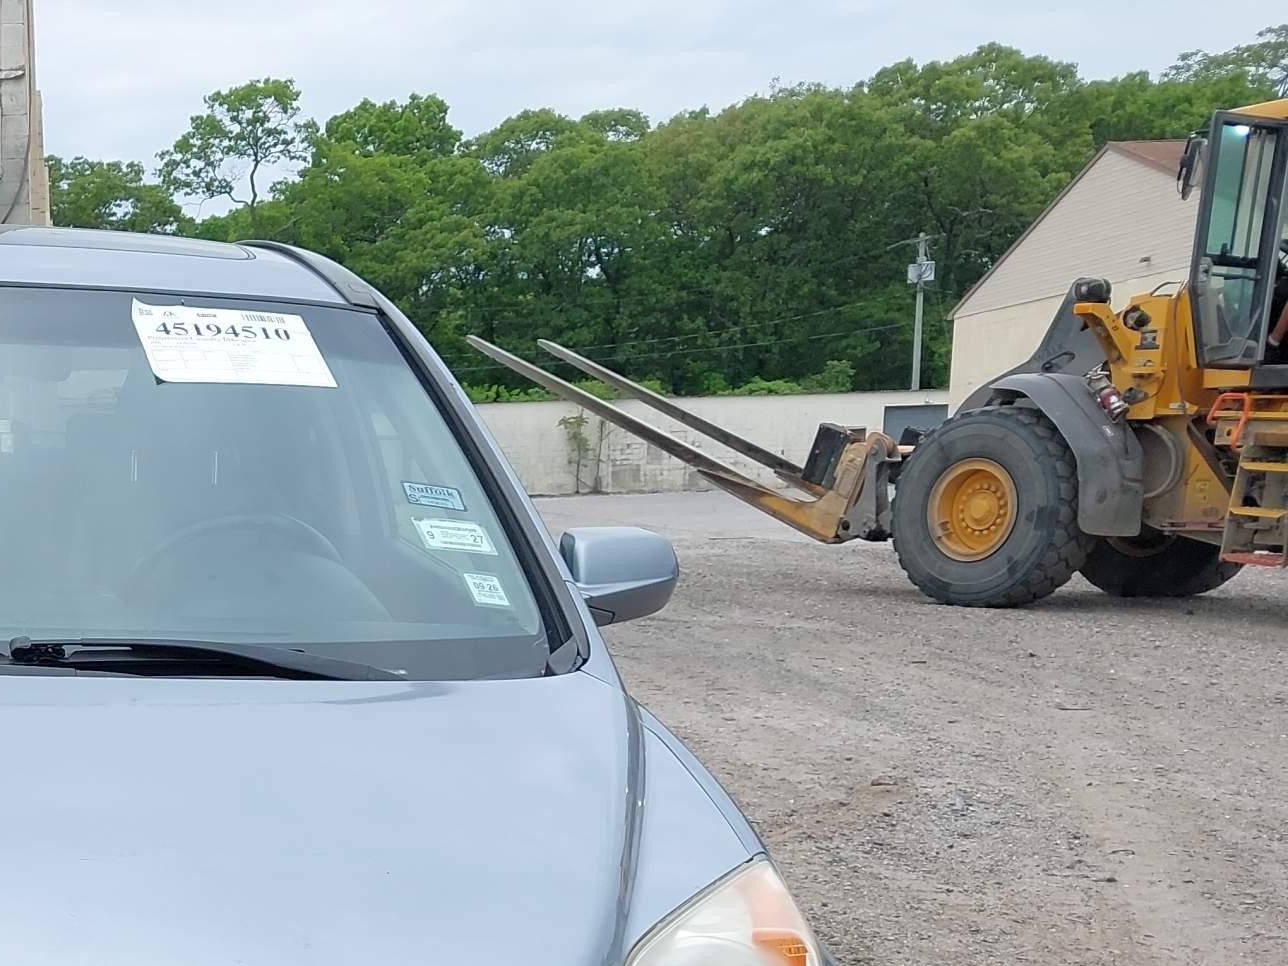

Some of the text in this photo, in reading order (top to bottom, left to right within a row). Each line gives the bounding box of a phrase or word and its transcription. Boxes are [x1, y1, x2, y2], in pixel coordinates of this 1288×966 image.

[155, 321, 291, 341] 45194510
[408, 484, 454, 498] Suffolk
[469, 534, 484, 545] 27
